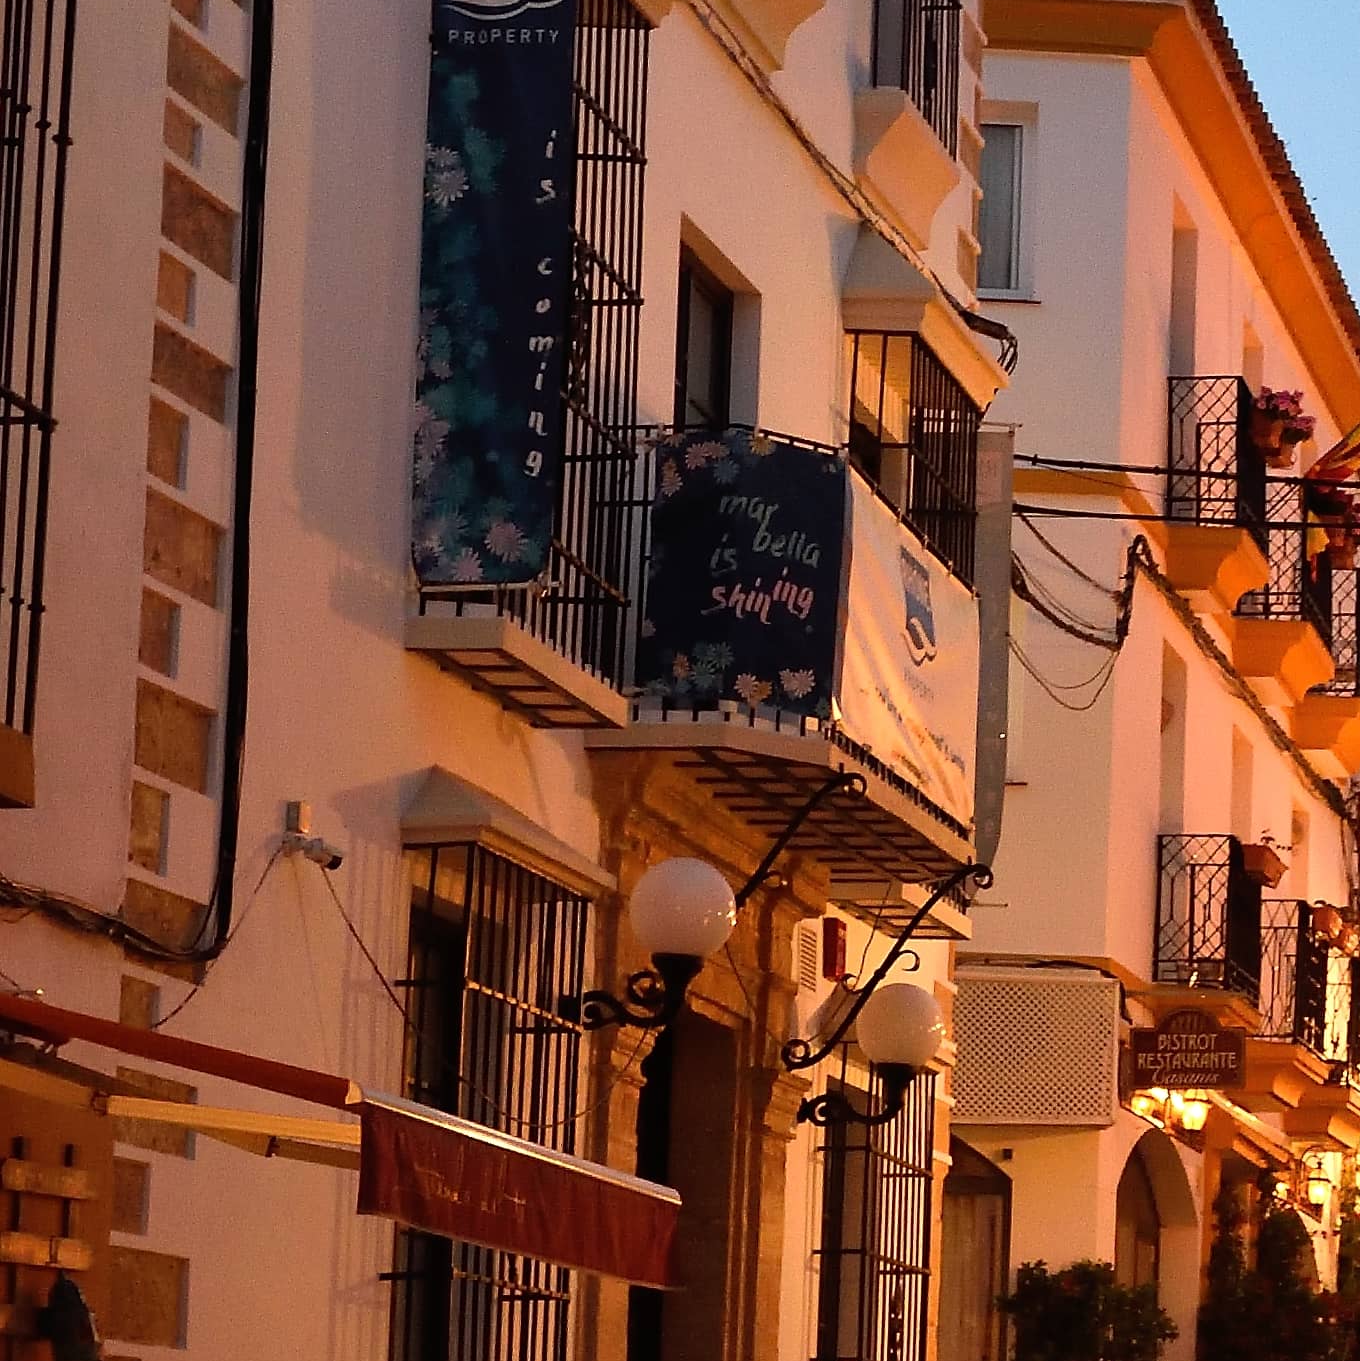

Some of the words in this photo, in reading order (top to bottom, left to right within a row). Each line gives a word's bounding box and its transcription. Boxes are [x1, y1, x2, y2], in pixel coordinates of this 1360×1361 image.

[447, 28, 559, 44] PROPERTY
[535, 128, 558, 205] is
[524, 256, 554, 479] coming
[701, 567, 814, 625] shining
[1137, 1051, 1238, 1070] RESTAURANTE
[1157, 1034, 1219, 1051] BISTROT
